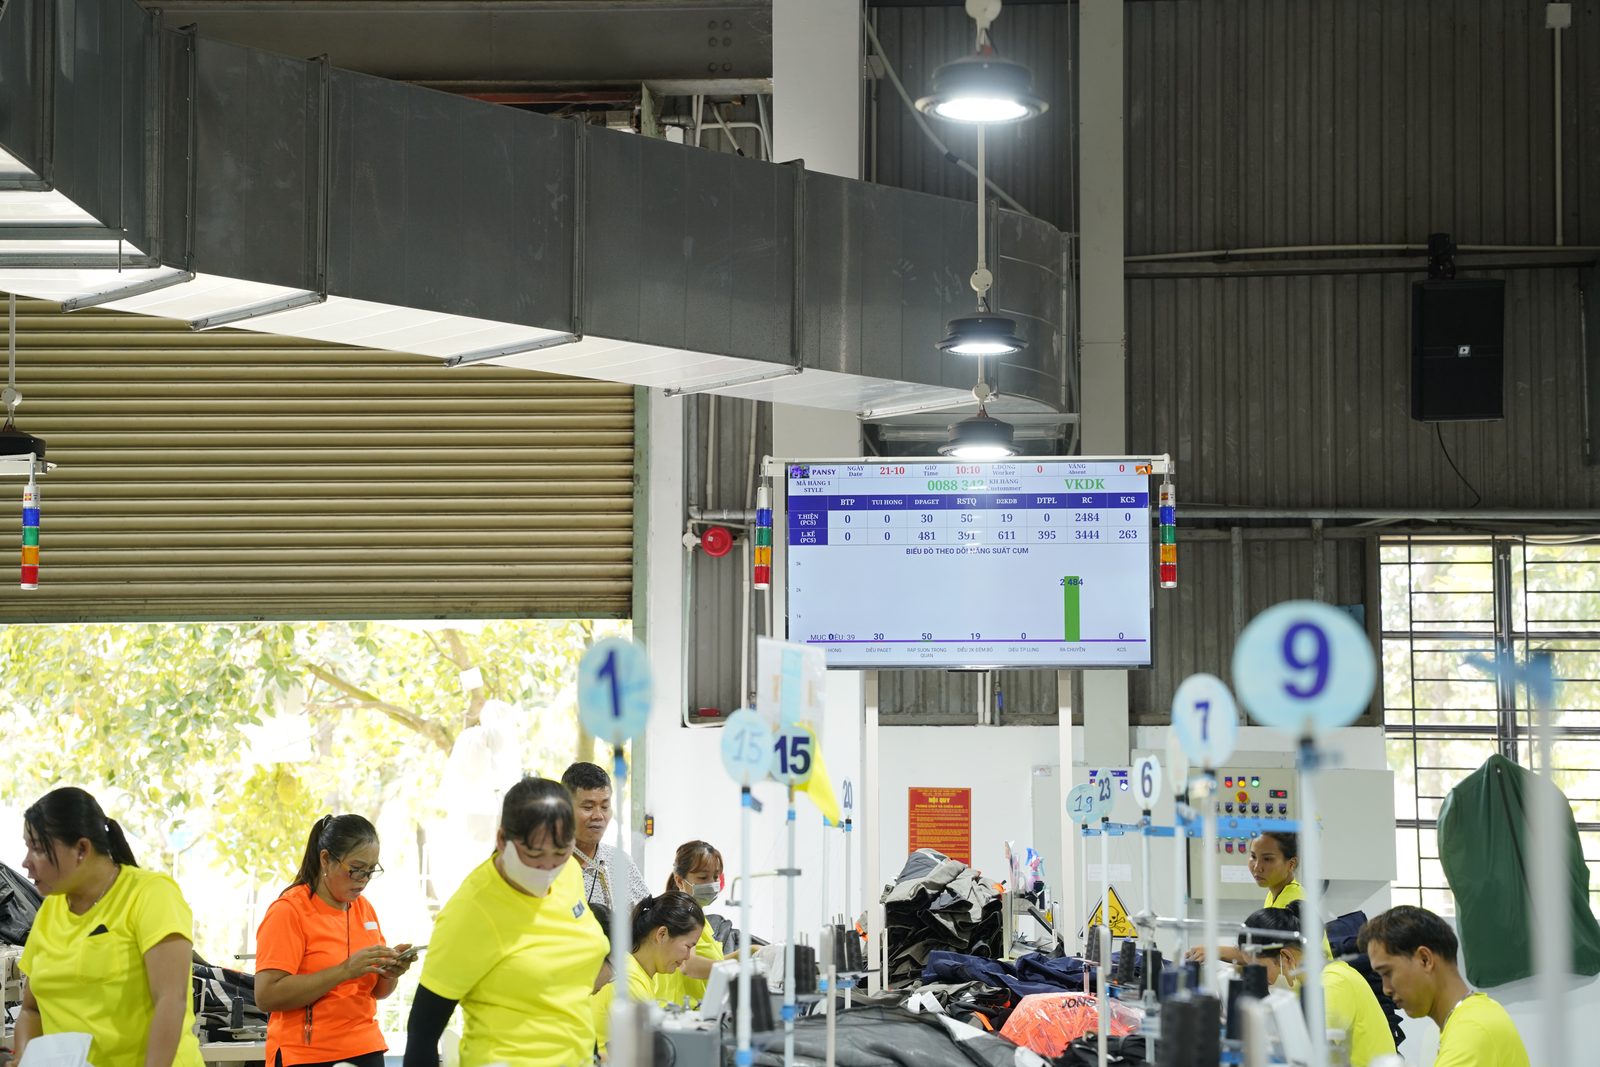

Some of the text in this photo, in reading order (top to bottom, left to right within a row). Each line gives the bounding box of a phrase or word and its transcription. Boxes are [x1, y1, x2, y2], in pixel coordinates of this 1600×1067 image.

[812, 468, 836, 476] PANSY
[879, 466, 905, 475] 21-10
[955, 466, 980, 475] 10:10
[1037, 465, 1043, 474] 0
[1119, 464, 1125, 473] 0
[927, 479, 958, 491] 0088
[1064, 478, 1105, 490] VKDK
[840, 498, 855, 506] BTP
[956, 498, 977, 507] RSTQ
[1036, 497, 1057, 505] DTPL
[1082, 496, 1093, 504] RC
[1120, 496, 1136, 504] KCS
[844, 512, 1131, 524] 0 0 30 50 19 0 2484 0
[844, 529, 1138, 541] 0 0 481 391 611 395 3444 263
[936, 547, 955, 555] THEO
[1059, 578, 1084, 586] 2 484
[873, 632, 884, 640] 30
[921, 632, 933, 640] 50
[970, 632, 981, 640] 19
[1020, 632, 1027, 640] 0
[1118, 632, 1124, 640] 0
[1281, 620, 1331, 700] 9
[597, 648, 621, 719] 1
[1193, 700, 1210, 742] 7
[733, 728, 765, 764] 15
[774, 735, 811, 775] 15
[1140, 760, 1153, 798] 6
[842, 779, 853, 810] 20
[1098, 777, 1111, 802] 23
[1073, 793, 1093, 813] 19
